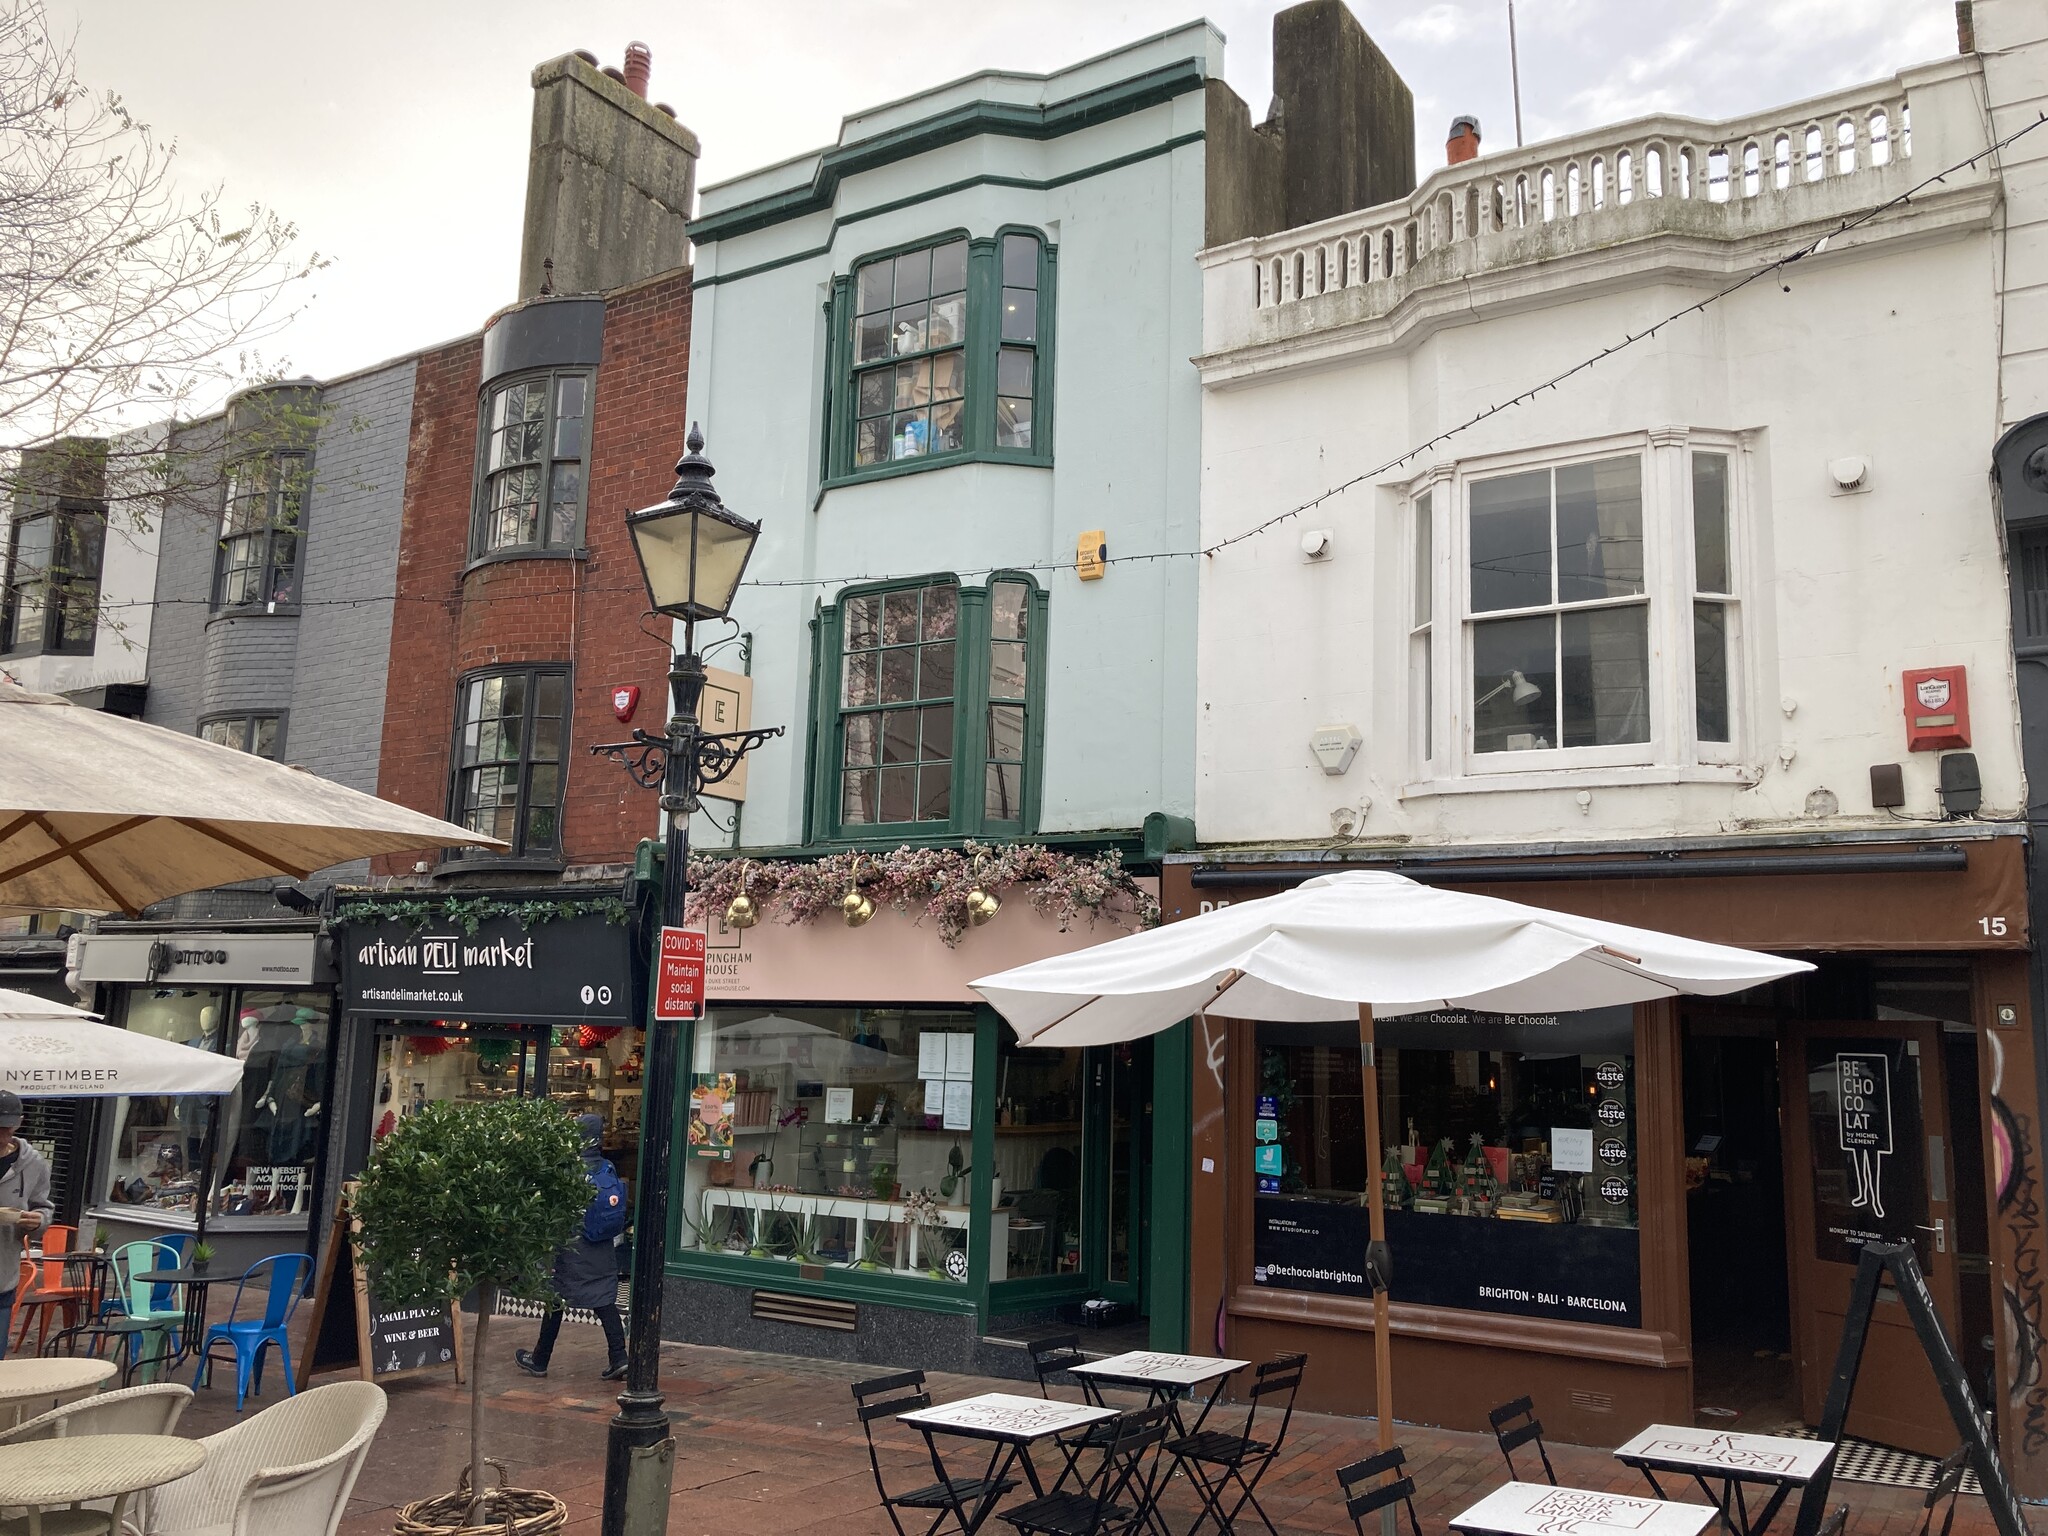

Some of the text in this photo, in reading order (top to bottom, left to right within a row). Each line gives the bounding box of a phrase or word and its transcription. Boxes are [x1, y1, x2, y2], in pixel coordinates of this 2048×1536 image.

[715, 700, 725, 723] E
[1979, 917, 2007, 936] 15
[358, 937, 535, 969] artisan DELI market
[666, 963, 700, 978] Maintain
[705, 964, 738, 975] HOUSE
[670, 981, 694, 994] social
[361, 988, 464, 1003] artisandelimarket.co.uk
[1400, 1014, 1413, 1022] We
[1430, 1013, 1470, 1024] Chocolat.
[1472, 1014, 1486, 1024] We
[1488, 1016, 1502, 1024] are
[1504, 1014, 1516, 1024] Be
[1518, 1015, 1560, 1026] Chocolat.
[6, 1069, 119, 1082] NYETIMBER
[1842, 1060, 1860, 1077] BE
[1596, 1071, 1624, 1081] taste
[1843, 1078, 1874, 1095] CHO
[1844, 1096, 1864, 1112] CO
[1598, 1109, 1626, 1120] taste
[1845, 1113, 1871, 1130] LAT
[1599, 1148, 1627, 1158] taste
[1604, 1142, 1620, 1150] great
[250, 1166, 306, 1174] NEW WEBSITE
[240, 1184, 312, 1192] www.mttoo.cm
[1600, 1186, 1628, 1196] taste
[1857, 1230, 1883, 1240] SATURDAY:
[1266, 1263, 1363, 1284] @bechocolatbrighton
[1479, 1286, 1627, 1312] BRIGHTON BALI BARCELONA
[380, 1310, 409, 1323] SMALL
[384, 1327, 440, 1344] WINE & BEER
[1663, 1443, 1784, 1463] EXCITED
[1706, 1456, 1778, 1469] STAY
[1552, 1496, 1613, 1510] YOUR
[1556, 1492, 1650, 1509] FOLLOW
[1534, 1508, 1613, 1523] MUSIC
[1542, 1502, 1613, 1516] INNER
